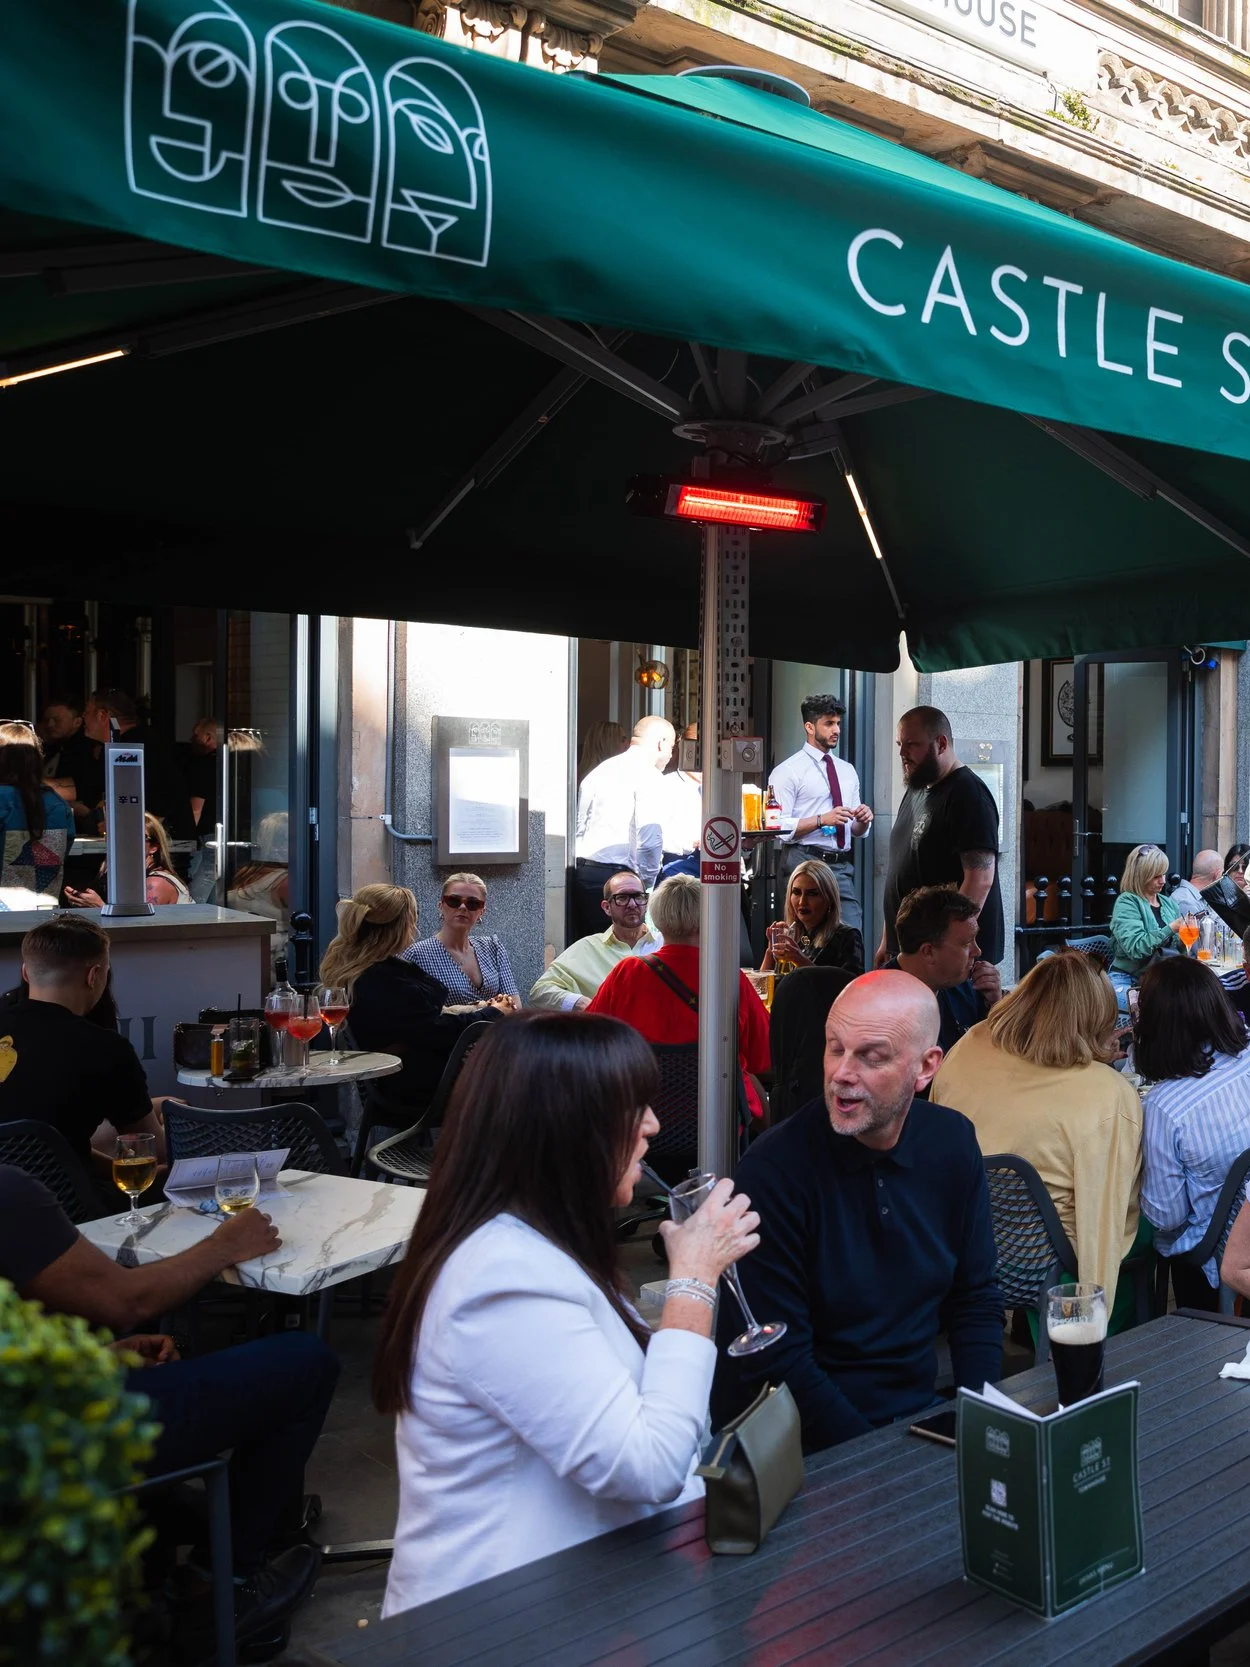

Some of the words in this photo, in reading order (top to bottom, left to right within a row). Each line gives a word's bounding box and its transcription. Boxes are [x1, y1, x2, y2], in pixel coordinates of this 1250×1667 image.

[847, 227, 1184, 389] CASTLE
[714, 863, 727, 871] No
[703, 873, 738, 882] smoking
